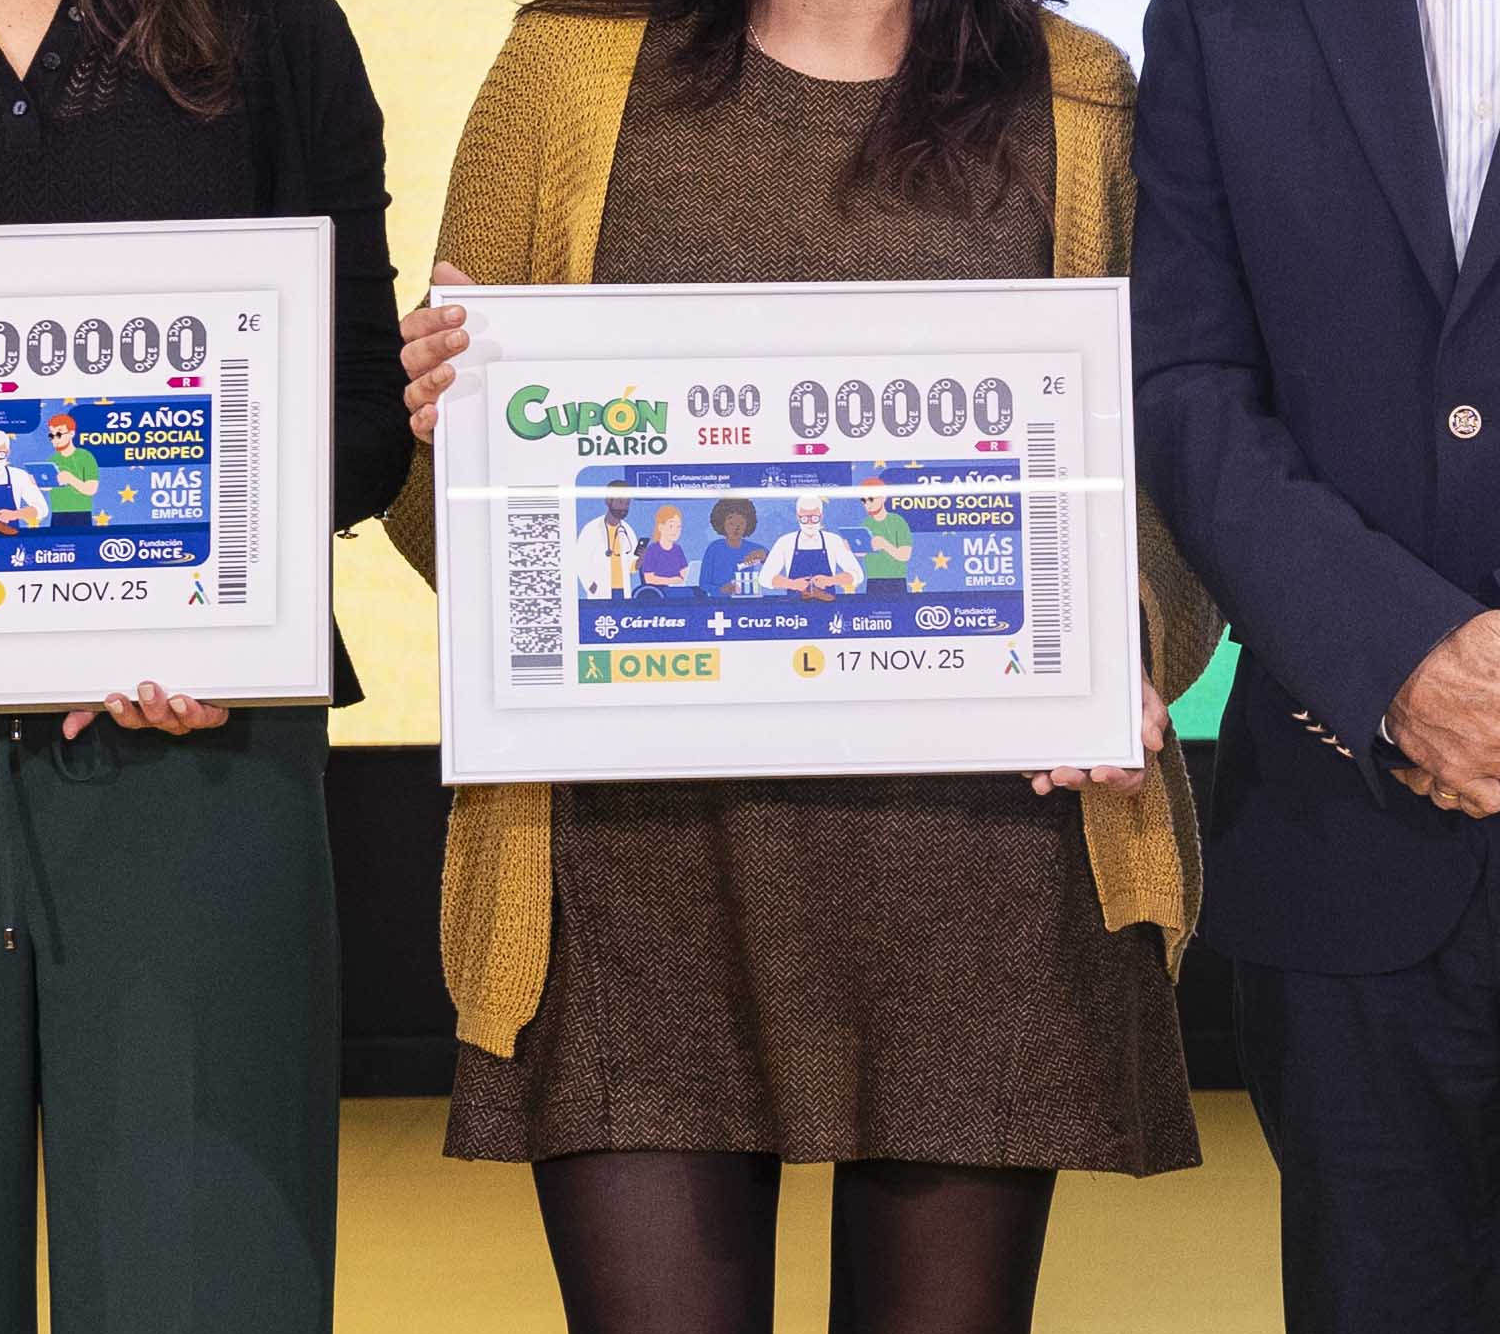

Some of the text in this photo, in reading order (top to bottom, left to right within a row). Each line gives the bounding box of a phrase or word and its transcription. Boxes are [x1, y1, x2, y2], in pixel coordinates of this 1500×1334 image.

[237, 312, 261, 331] 2€
[1042, 375, 1066, 394] 2€
[106, 405, 203, 429] 25 AÑOS
[79, 429, 203, 445] FONDO SOCIAL
[698, 427, 751, 445] SERIE
[124, 445, 203, 460] EUROPEO
[151, 466, 201, 489] MÁS
[150, 489, 201, 508] QUE
[891, 494, 1012, 510] FONDO SOCIAL
[152, 508, 202, 519] EMPLEO
[936, 511, 1013, 526] EUROPEO
[139, 538, 182, 547] Fundación
[963, 533, 1012, 555] MÁS
[35, 548, 75, 563] Gitano
[138, 546, 182, 559] ONCE
[963, 556, 1013, 575] QUE
[965, 575, 1014, 586] EMPLEO
[17, 580, 147, 603] 17 NOV. 25
[954, 606, 996, 615] Fundación
[620, 615, 685, 628] Cáritas
[737, 615, 807, 629] Cruz Roja
[852, 615, 891, 630] Gitano
[953, 615, 996, 627] ONCE
[618, 653, 712, 677] ONCE
[836, 649, 964, 670] 17 NOV. 25
